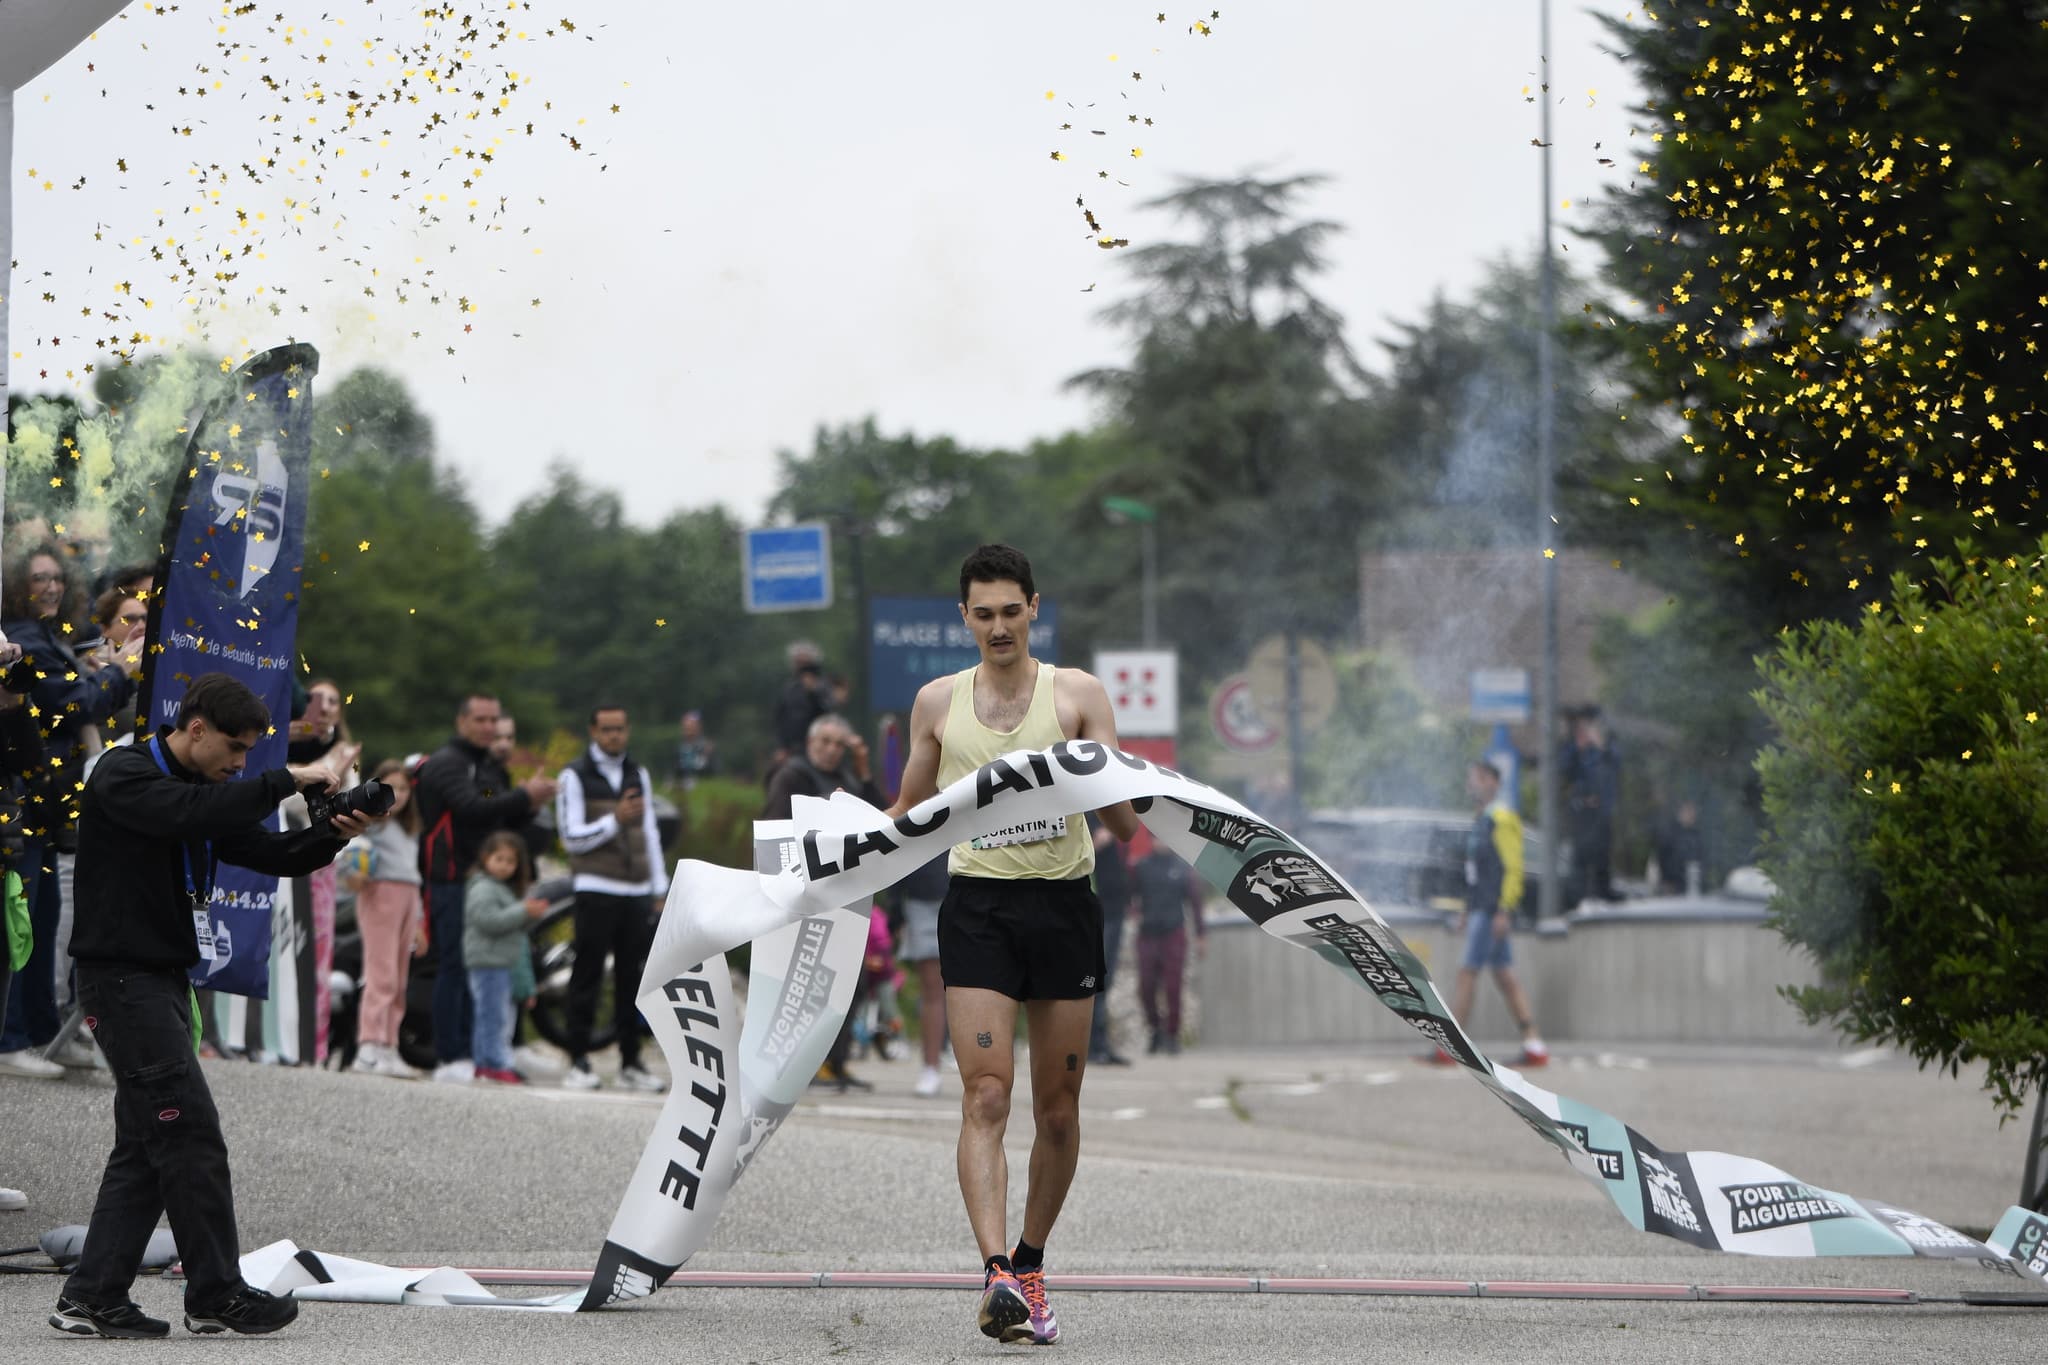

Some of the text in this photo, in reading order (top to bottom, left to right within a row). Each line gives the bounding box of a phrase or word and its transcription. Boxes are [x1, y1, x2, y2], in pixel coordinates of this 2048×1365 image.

[803, 807, 950, 881] LAC
[656, 962, 728, 1211] ELETTE
[1729, 1186, 1786, 1208] TOUR
